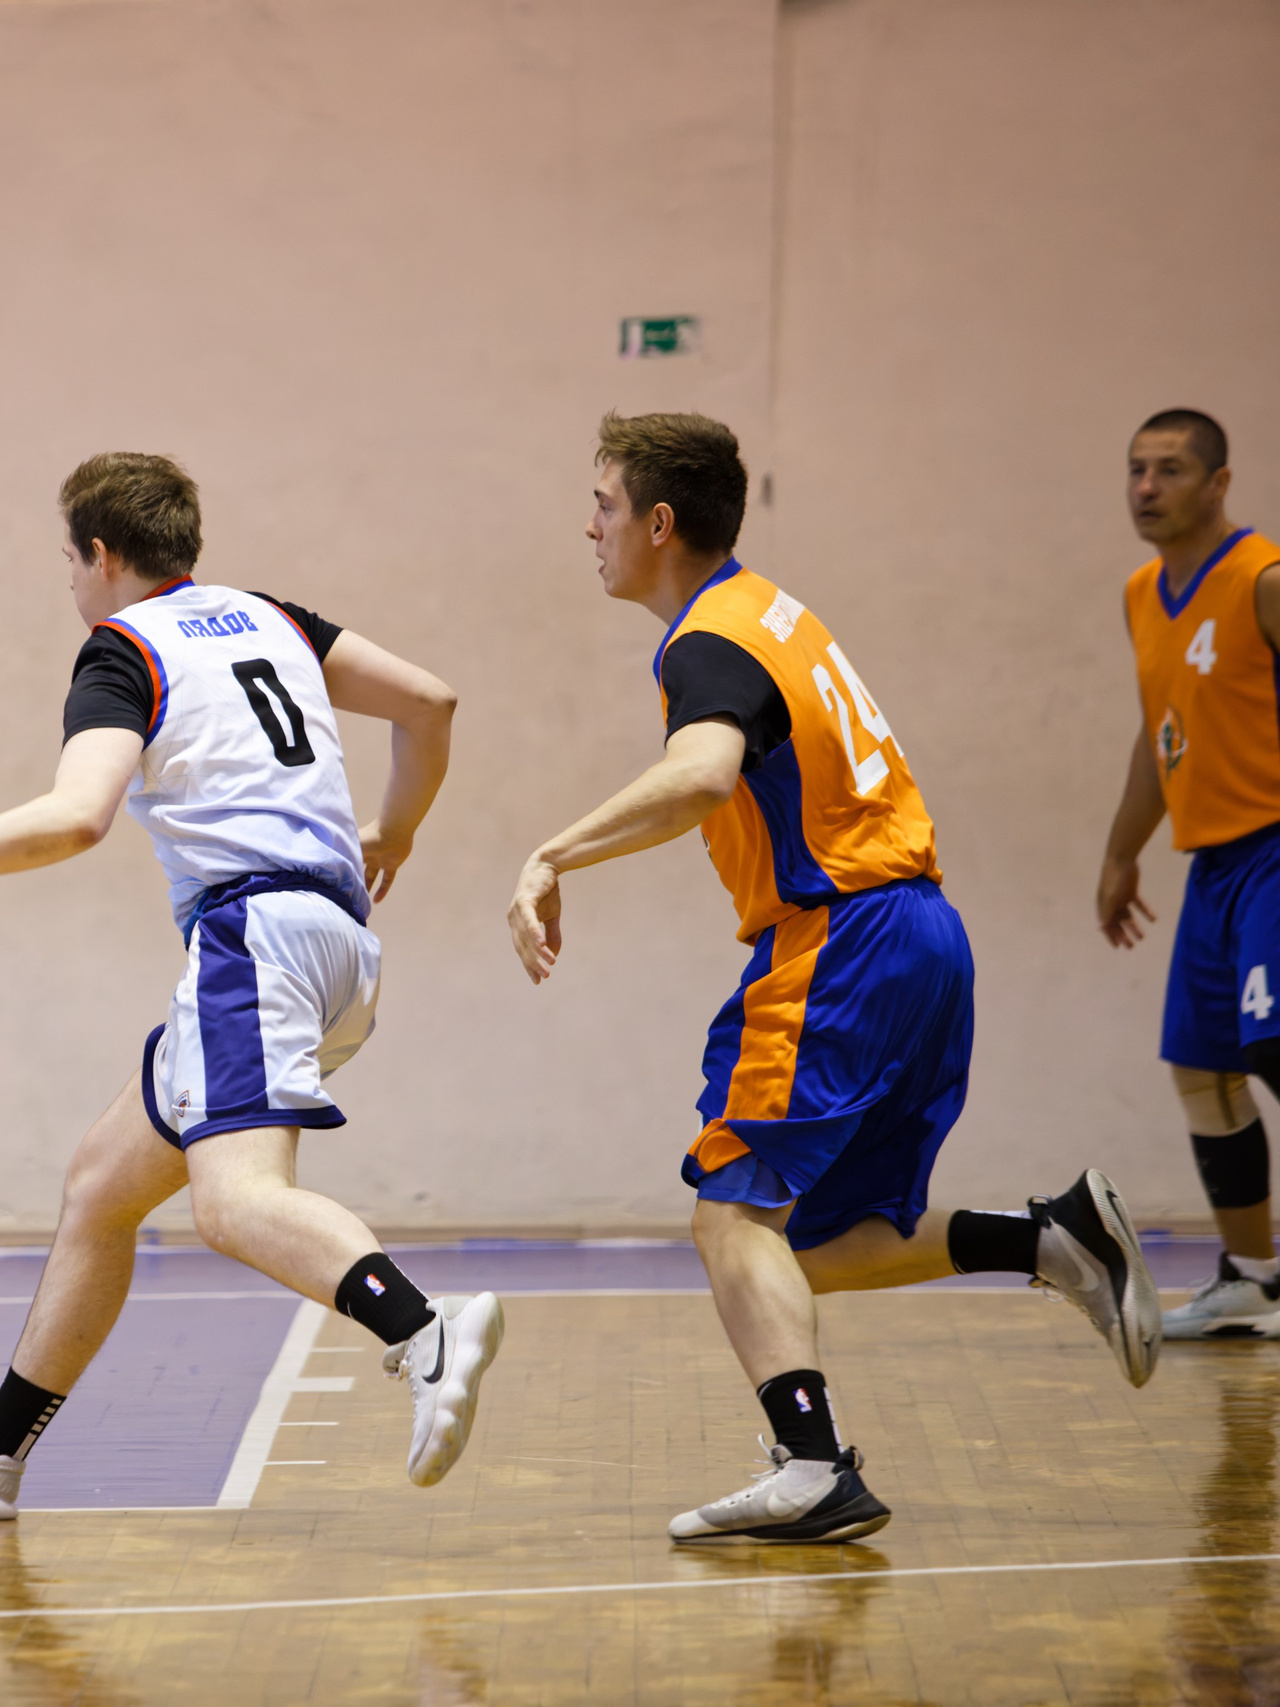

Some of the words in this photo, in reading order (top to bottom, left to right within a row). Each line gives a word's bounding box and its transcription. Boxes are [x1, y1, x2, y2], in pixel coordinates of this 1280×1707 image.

[1185, 618, 1218, 675] 4
[231, 658, 316, 768] 0
[811, 641, 905, 797] 24
[1240, 964, 1275, 1020] 4
